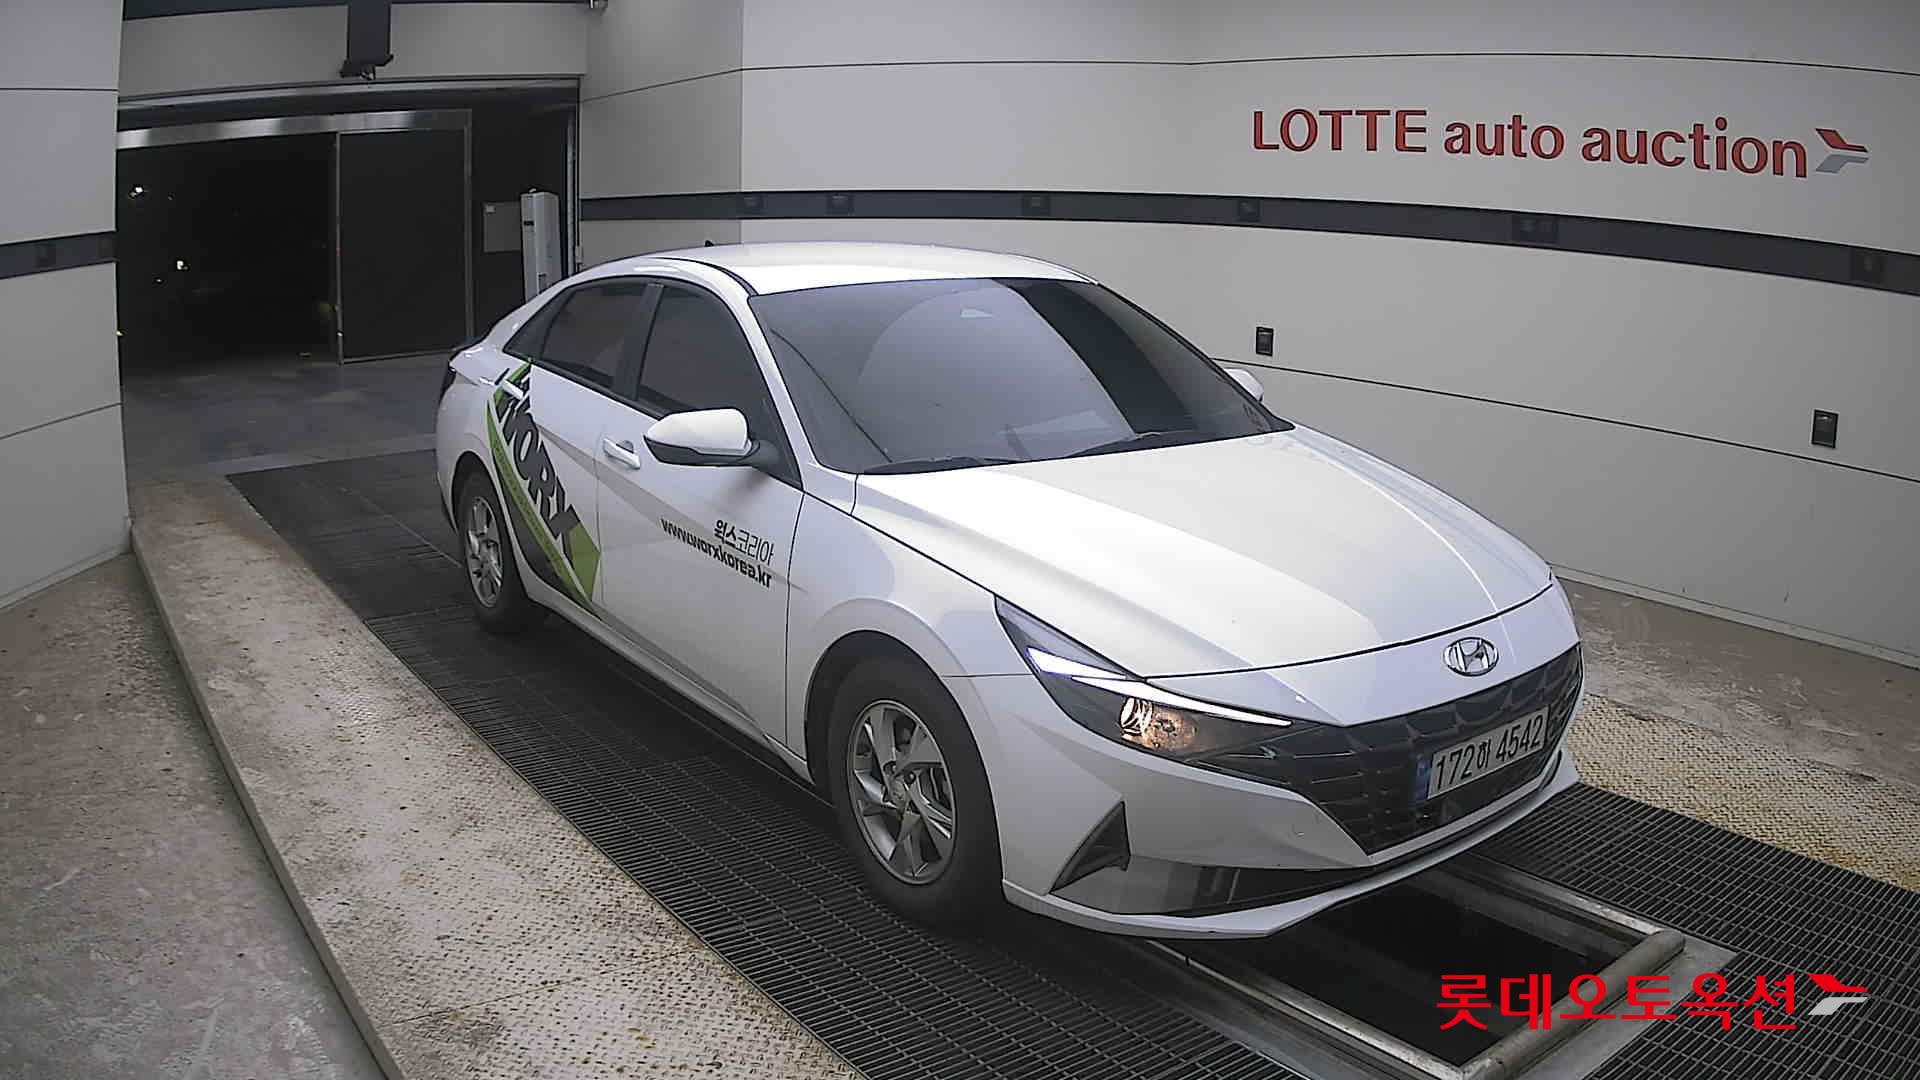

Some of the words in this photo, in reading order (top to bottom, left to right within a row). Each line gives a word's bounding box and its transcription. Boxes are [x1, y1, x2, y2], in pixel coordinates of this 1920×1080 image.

[1253, 109, 1428, 153] LOTTE
[1443, 114, 1566, 159] auto
[1581, 115, 1808, 178] auction
[660, 518, 772, 588] www.worxkorea.kr
[714, 519, 774, 566] 웍스코리아
[1496, 714, 1543, 762] 4542
